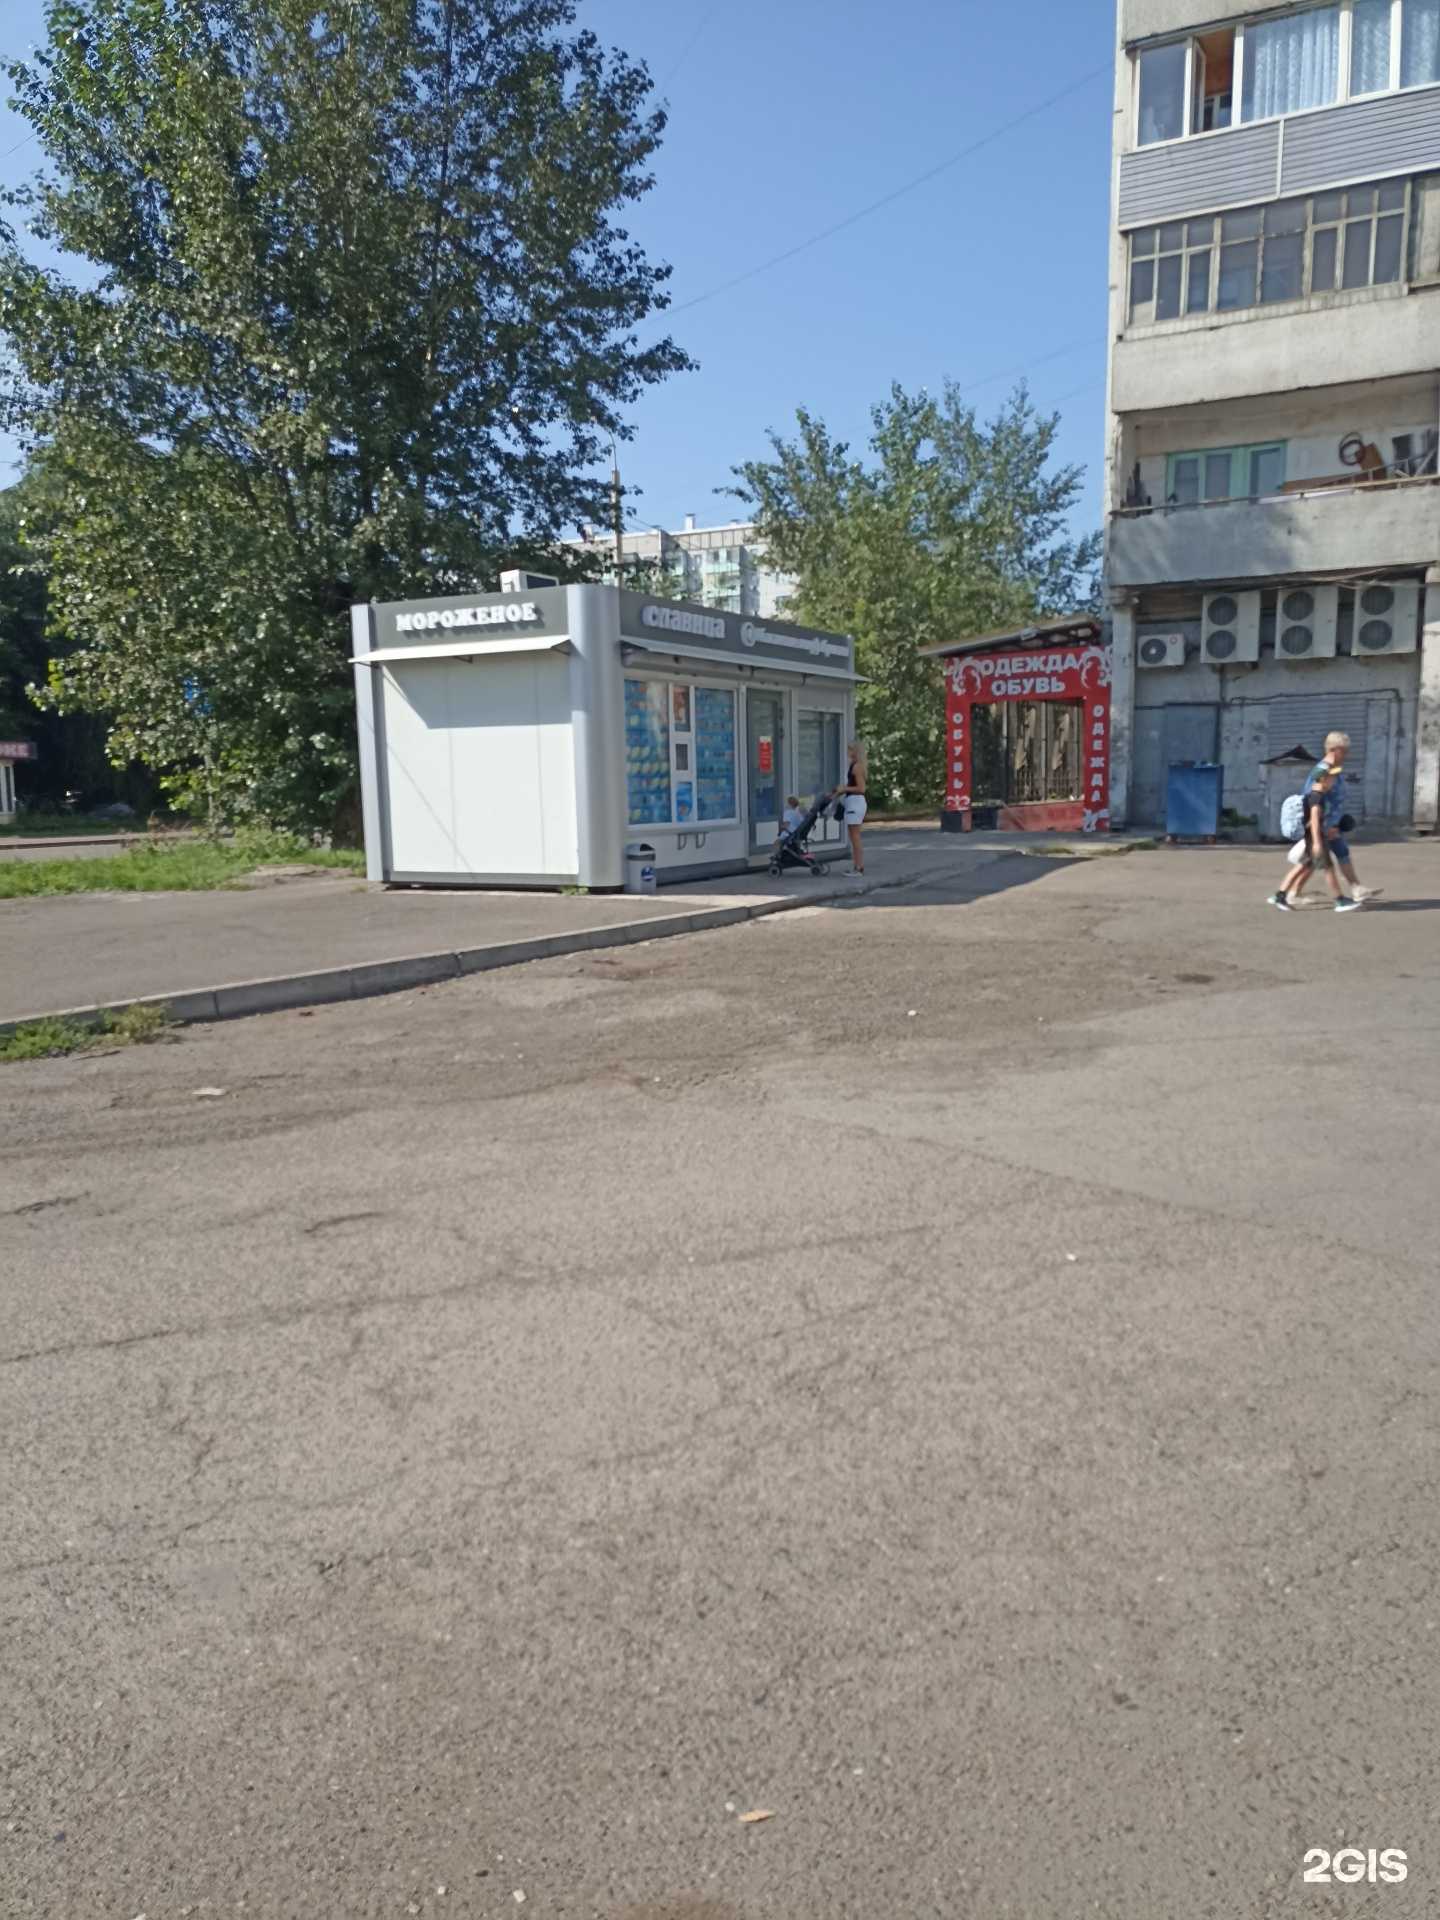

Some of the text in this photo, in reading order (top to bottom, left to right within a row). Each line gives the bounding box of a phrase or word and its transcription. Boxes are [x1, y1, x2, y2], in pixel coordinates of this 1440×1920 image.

[396, 602, 537, 631] МОРОЖЕНОЕ
[980, 653, 1080, 677] ОДЕЖДА
[991, 677, 1066, 696] ОБУВЬ
[952, 712, 964, 789] ОБУВЬ
[1090, 704, 1105, 802] ОДЕЖДА
